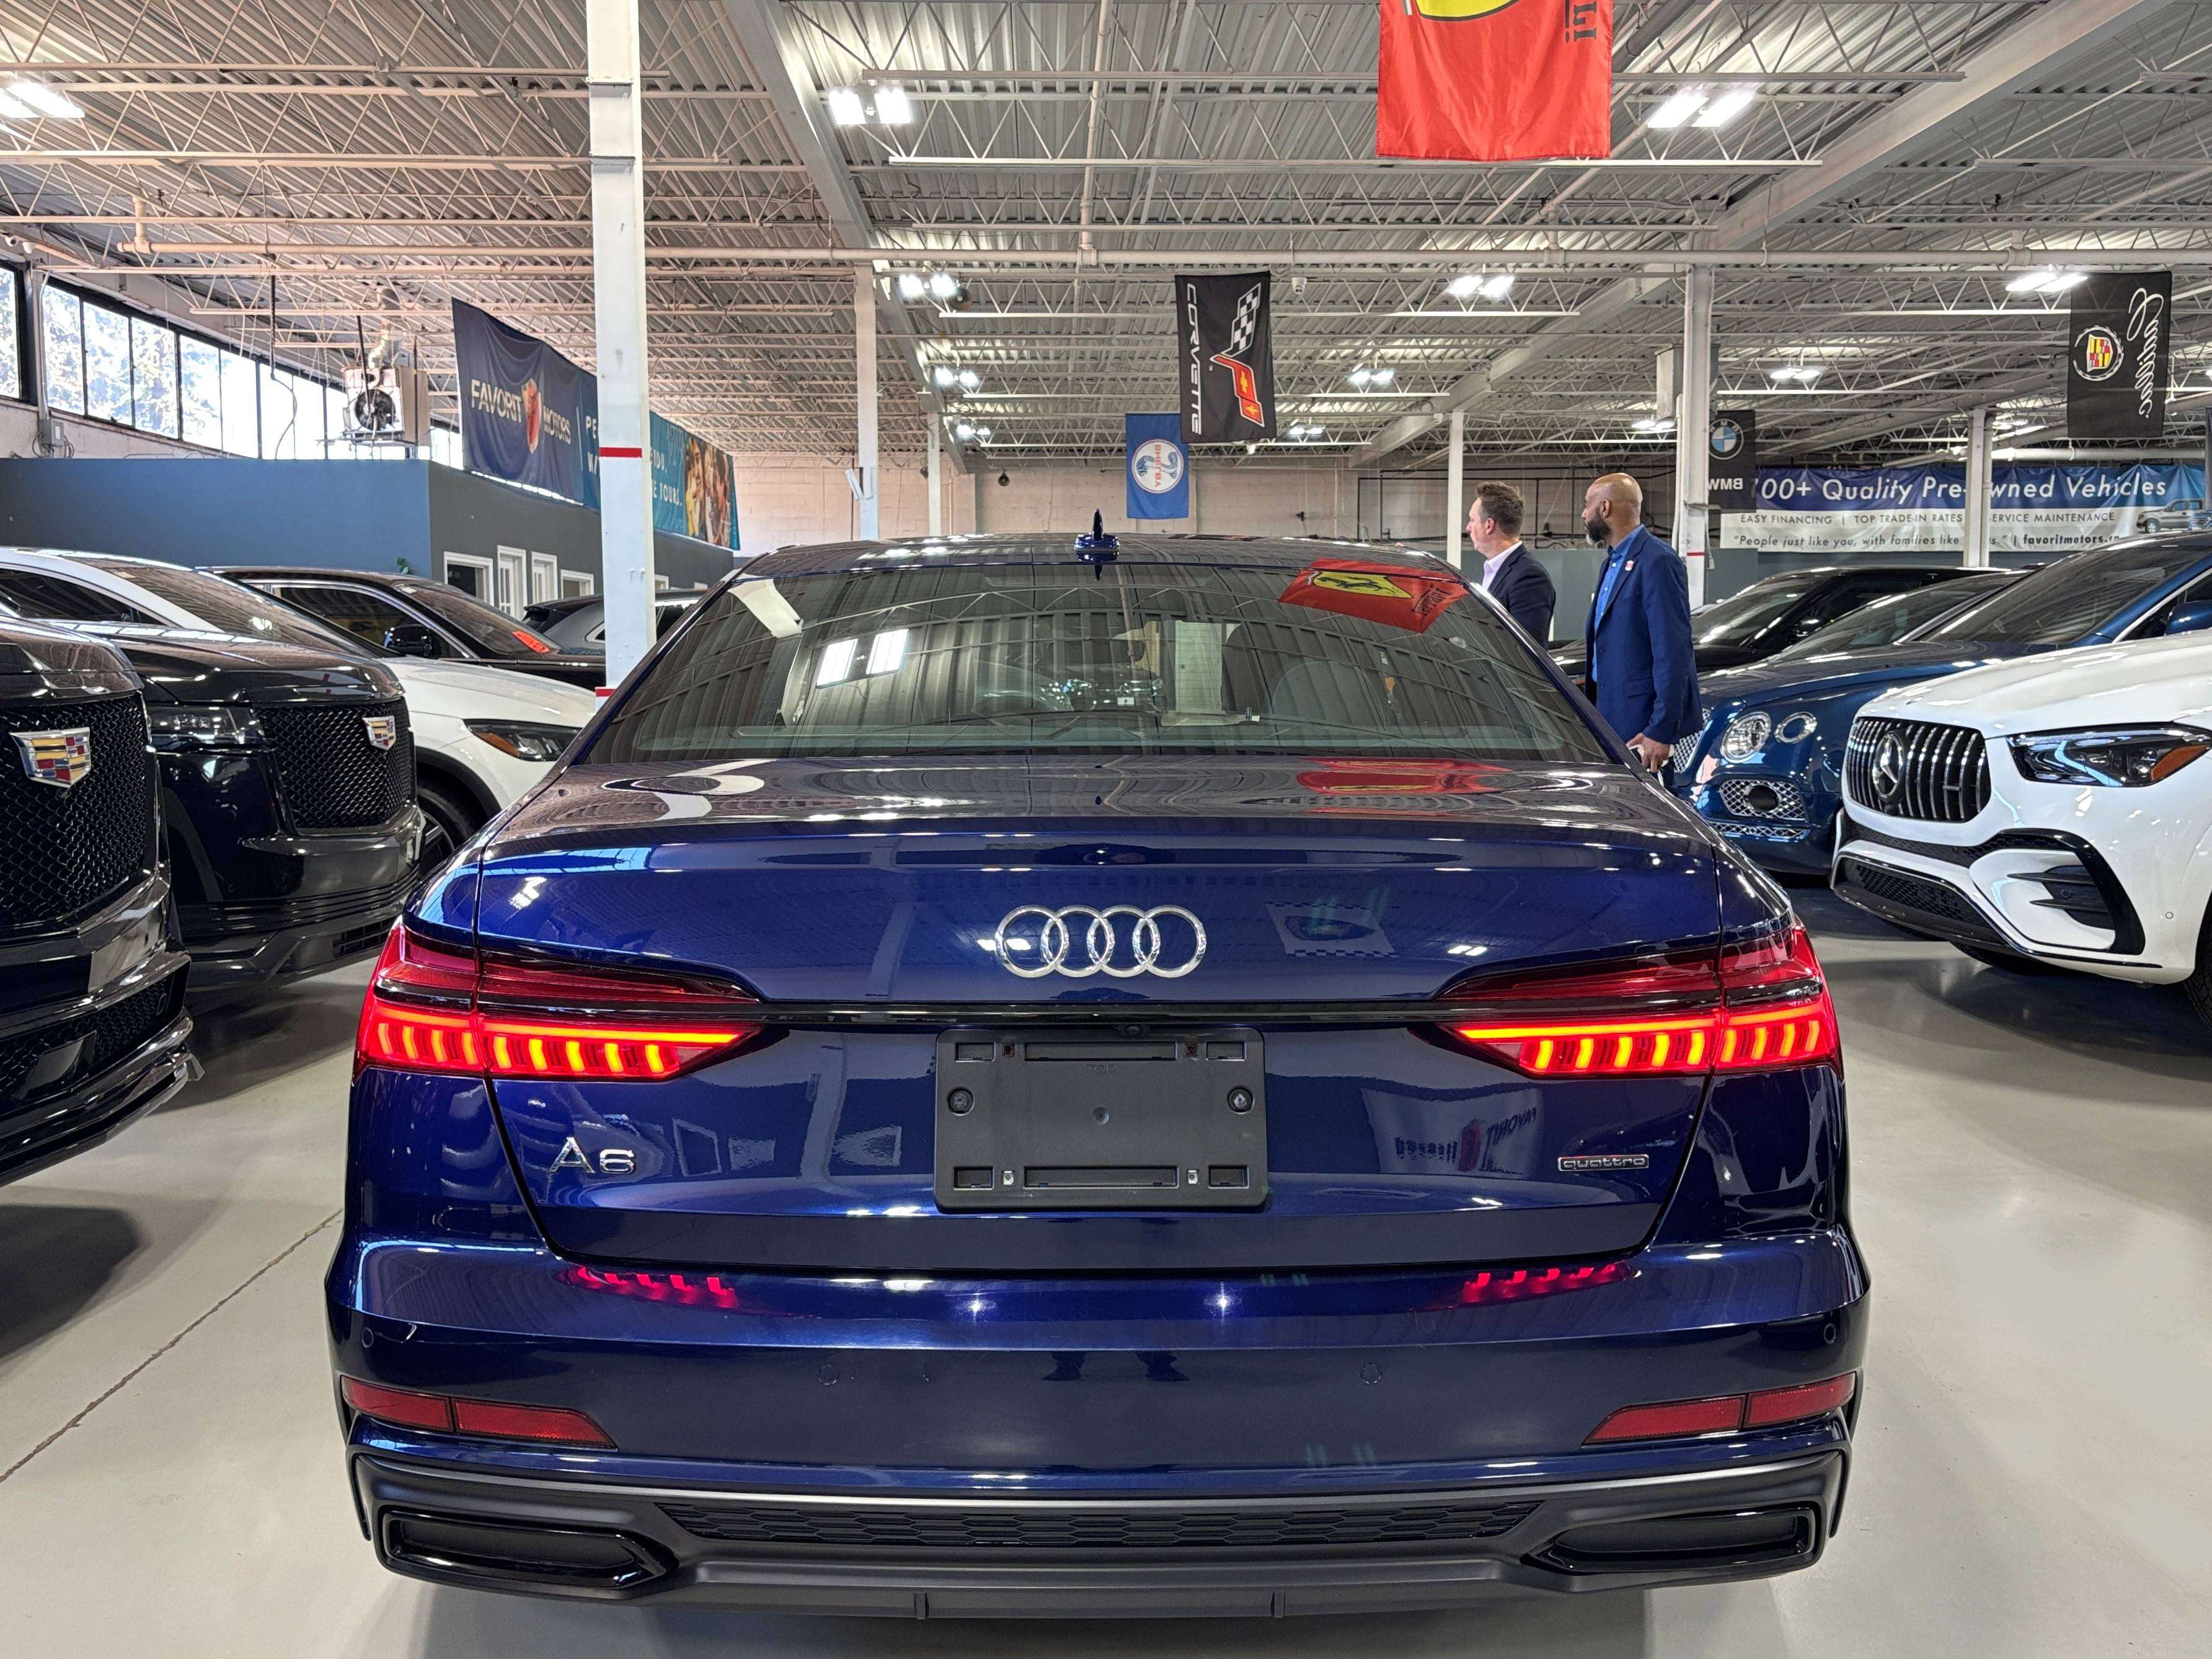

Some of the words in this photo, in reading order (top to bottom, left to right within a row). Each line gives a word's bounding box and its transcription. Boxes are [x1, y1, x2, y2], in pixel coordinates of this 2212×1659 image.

[1186, 283, 1202, 435] CORVETTE
[471, 379, 522, 423] FAVORIT
[543, 405, 572, 445] MOTORS
[1823, 476, 1913, 505] Quality
[2066, 472, 2167, 498] Vehicles
[1741, 515, 1767, 523] EASY
[1771, 515, 1833, 524] FINANCING
[1855, 515, 1875, 523] TOP
[1880, 514, 1927, 523] TRADE-IN
[1932, 514, 1963, 522] RATES
[1989, 513, 2029, 523] ERVICE
[2033, 513, 2115, 523] MAINTENANCE
[1782, 536, 1805, 548] just
[1809, 536, 1829, 546] like
[1833, 539, 1856, 547] you,
[1862, 536, 1885, 545] with
[1890, 534, 1935, 546] families
[1939, 534, 1960, 544] like
[549, 1136, 635, 1174] A6
[1563, 1156, 1646, 1170] quattro
